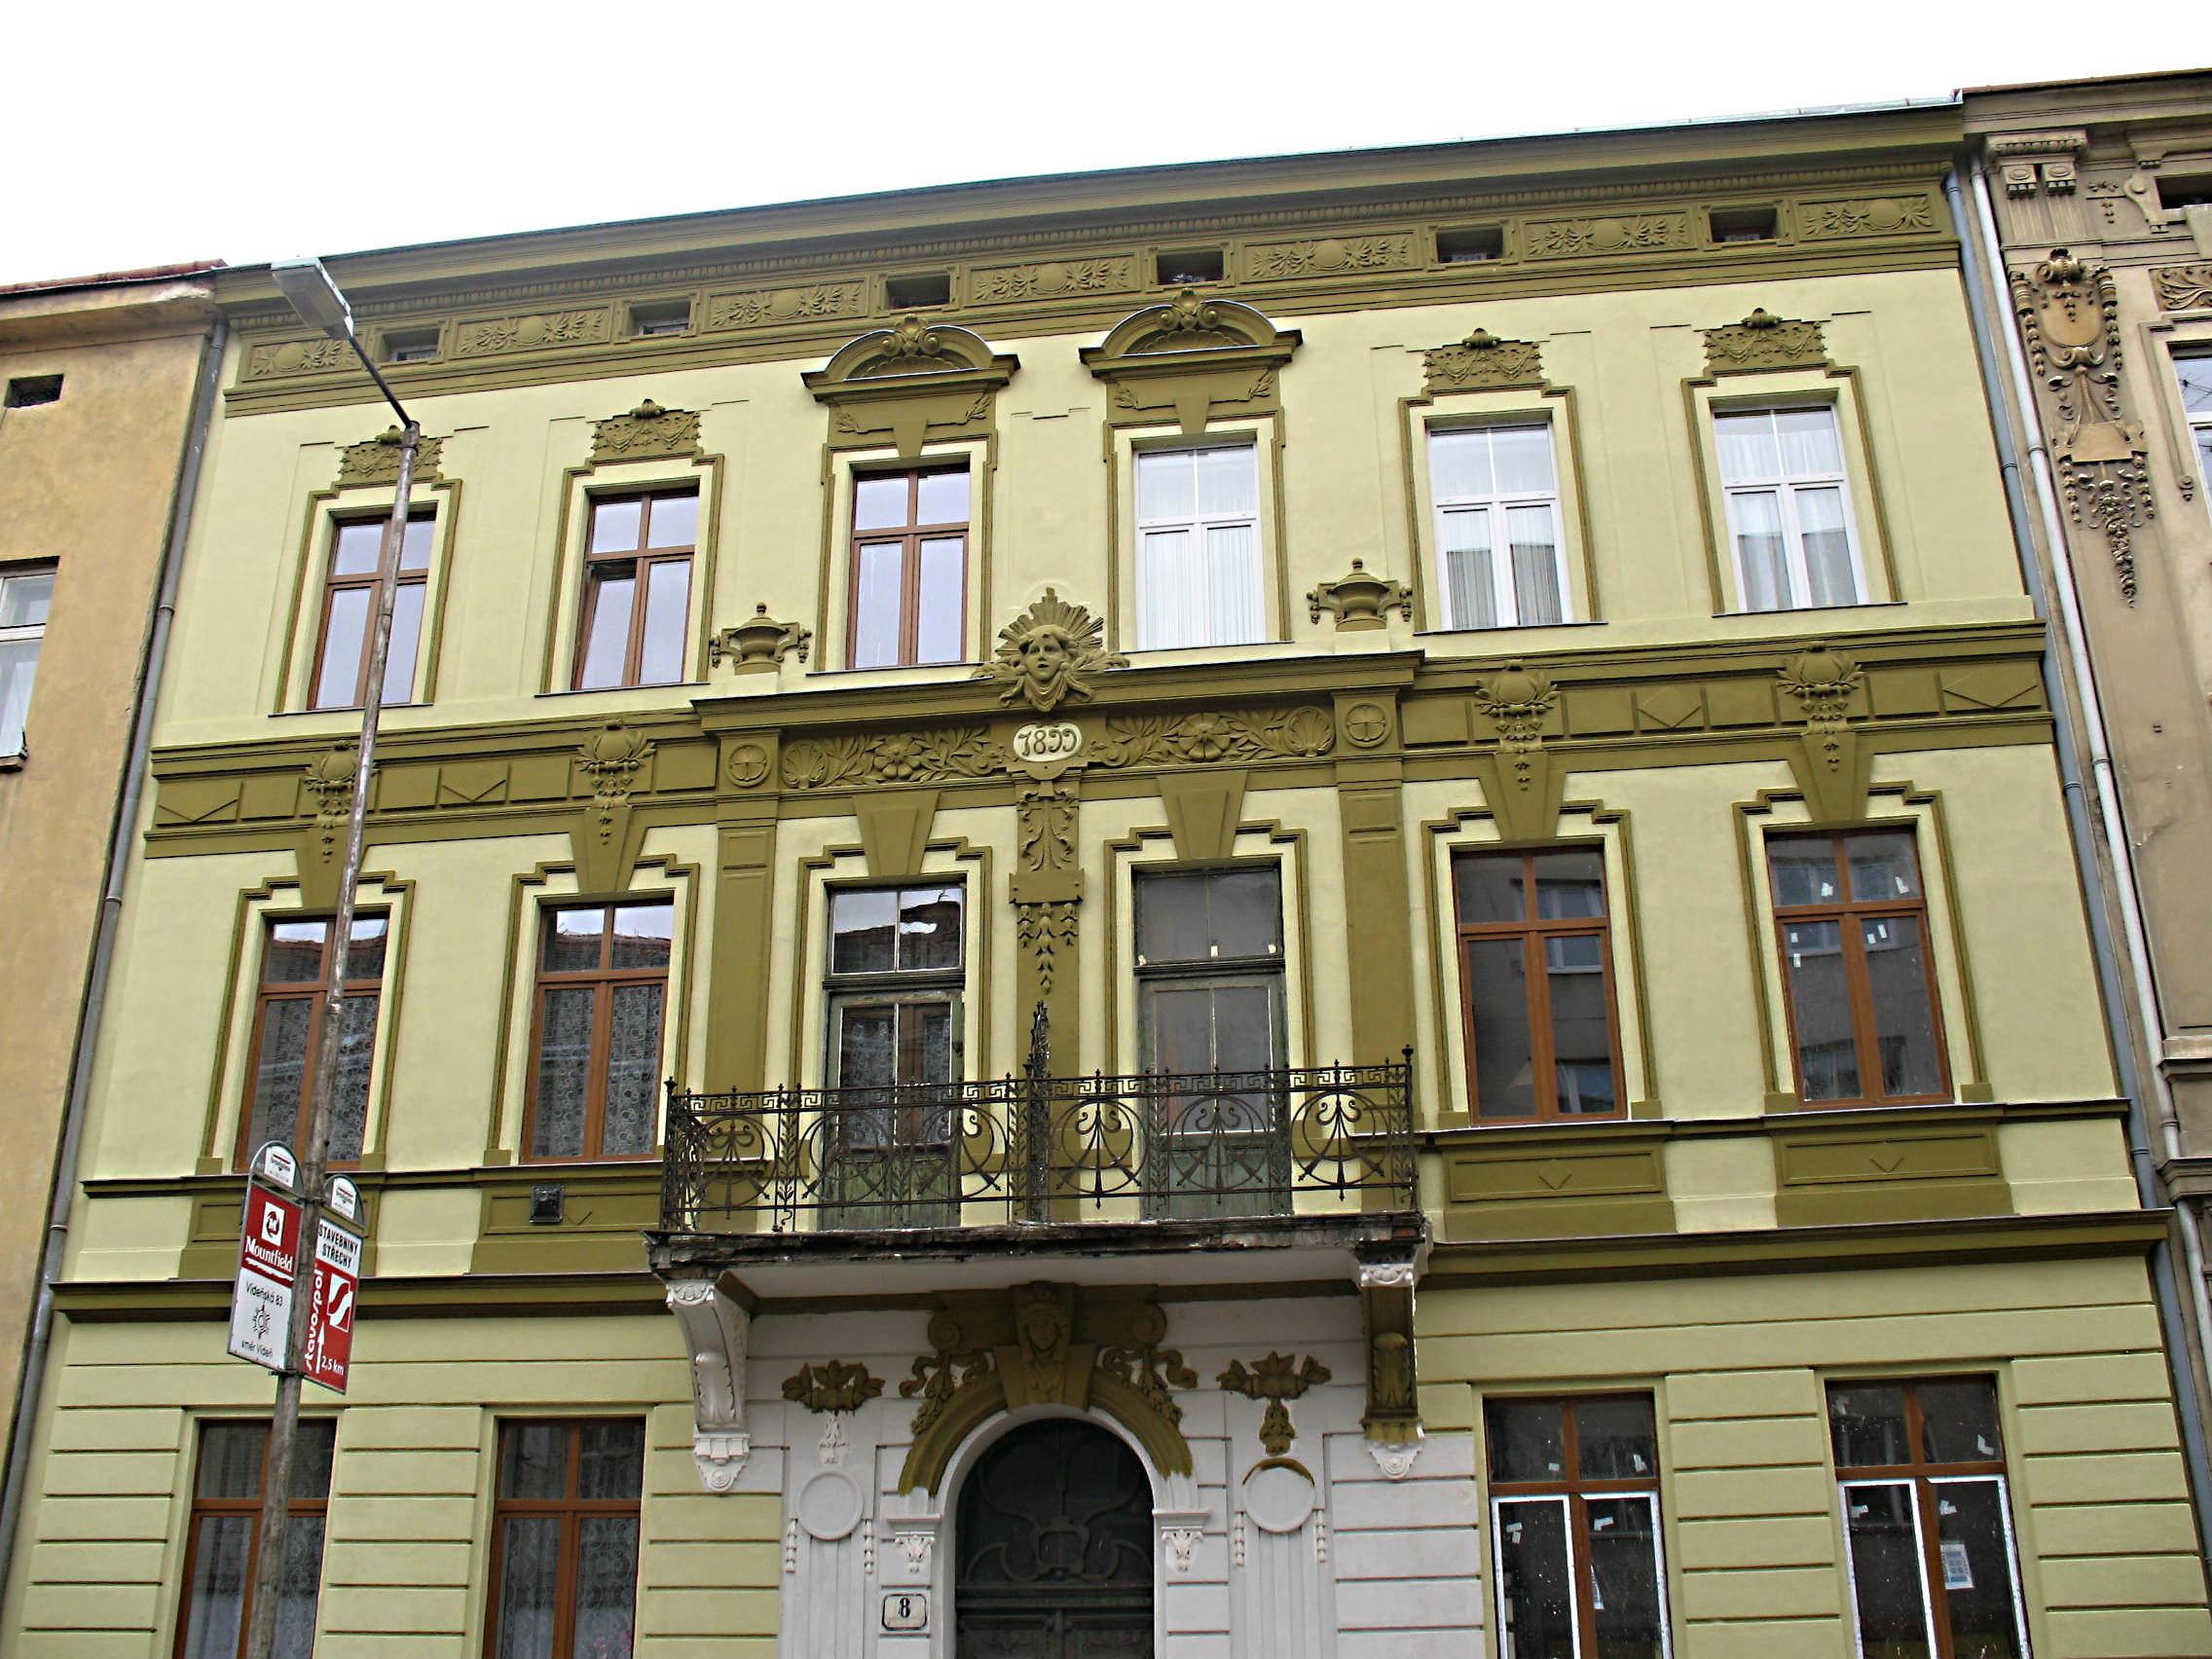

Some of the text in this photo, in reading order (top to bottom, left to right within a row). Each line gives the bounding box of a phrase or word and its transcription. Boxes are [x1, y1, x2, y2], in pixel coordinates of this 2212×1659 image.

[318, 1224, 358, 1255] STAVEBNINY
[244, 1235, 293, 1272] Mountfield
[321, 1243, 352, 1269] STŘECHY
[275, 1294, 283, 1307] 83
[332, 1359, 344, 1376] km
[899, 1597, 911, 1618] 8
